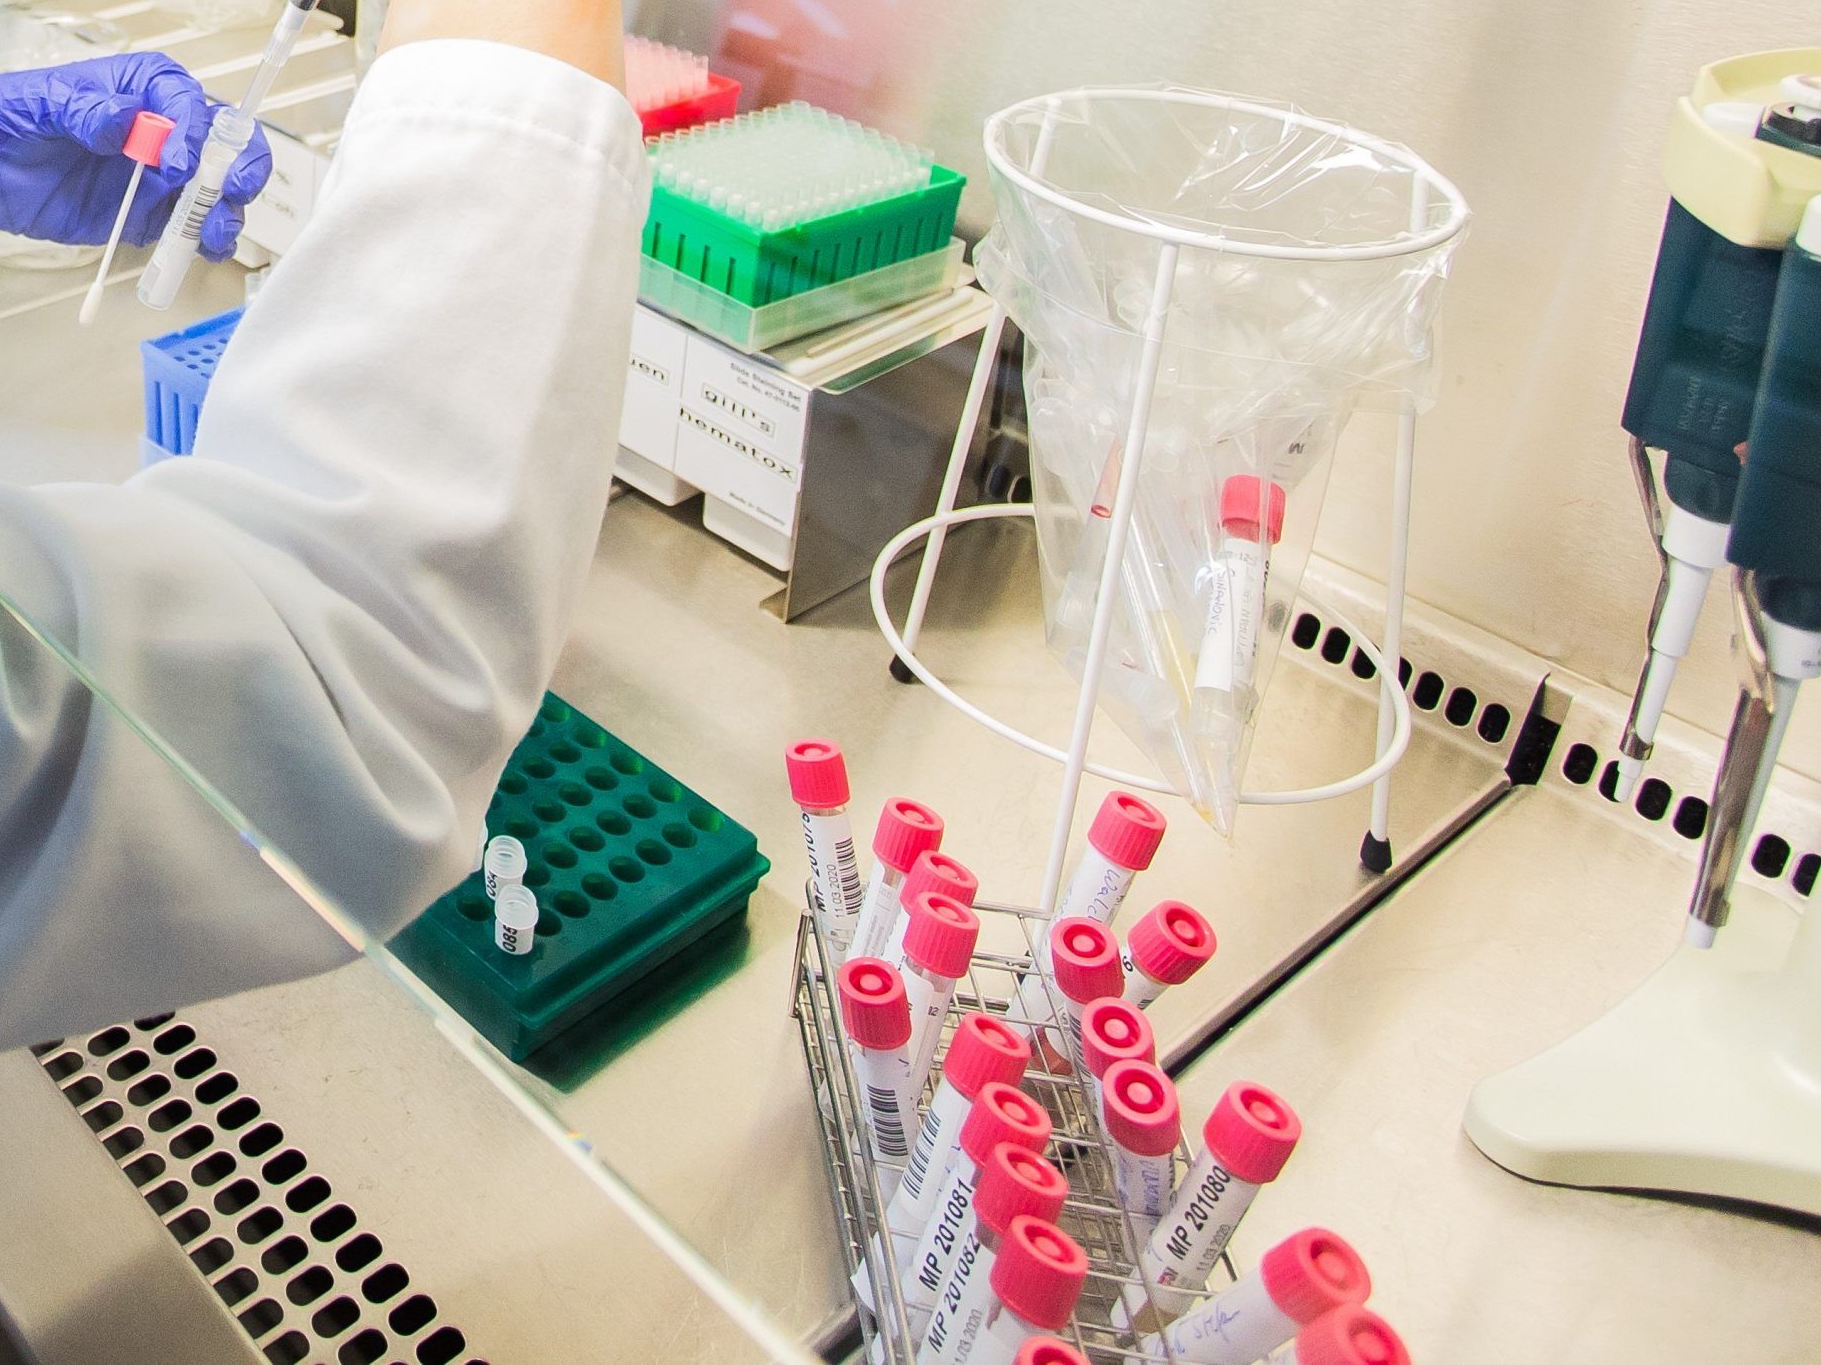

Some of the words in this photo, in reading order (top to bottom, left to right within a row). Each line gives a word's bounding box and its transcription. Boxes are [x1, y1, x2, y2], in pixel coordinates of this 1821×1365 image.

[680, 407, 793, 480] hematox
[705, 389, 771, 432] gill's
[813, 880, 827, 913] MP
[502, 924, 518, 953] 085
[918, 1251, 943, 1292] MP
[934, 1177, 973, 1256] 201081
[1166, 1225, 1193, 1261] MP
[1184, 1165, 1231, 1232] 201080
[927, 1311, 948, 1354] MP
[943, 1232, 981, 1315] 201082
